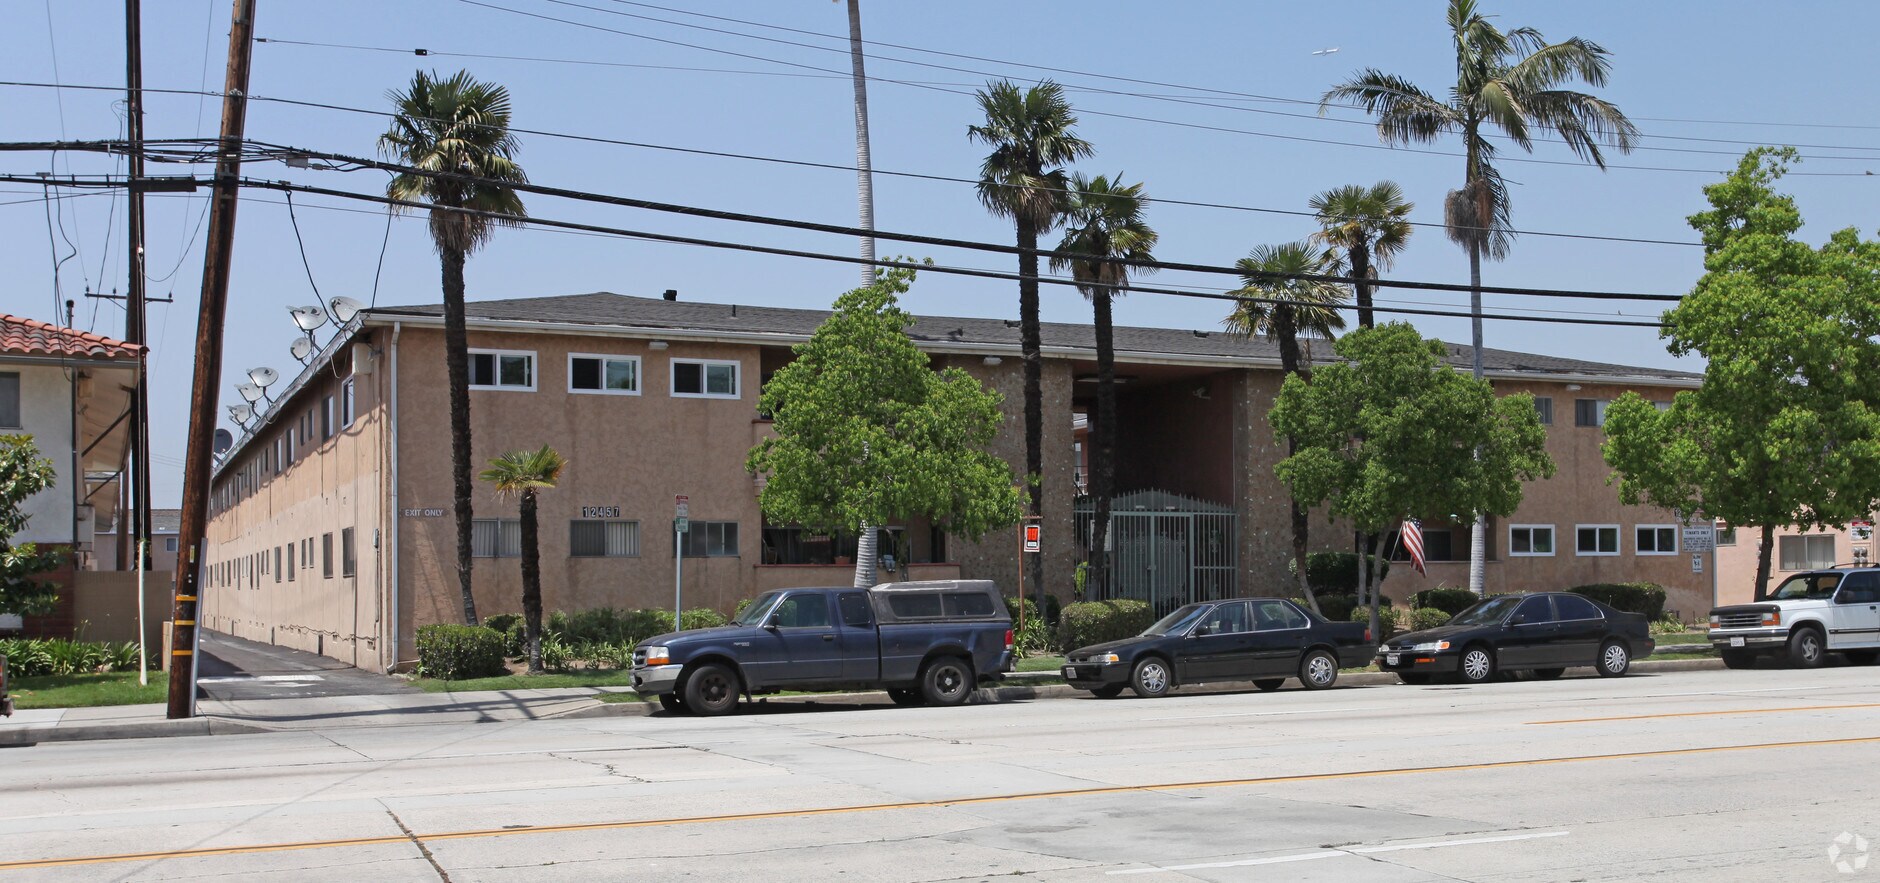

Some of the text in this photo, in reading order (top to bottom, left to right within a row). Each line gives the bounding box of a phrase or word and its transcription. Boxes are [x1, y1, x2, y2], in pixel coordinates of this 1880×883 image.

[404, 509, 443, 517] EXIT ONLY
[583, 507, 620, 517] 12457
